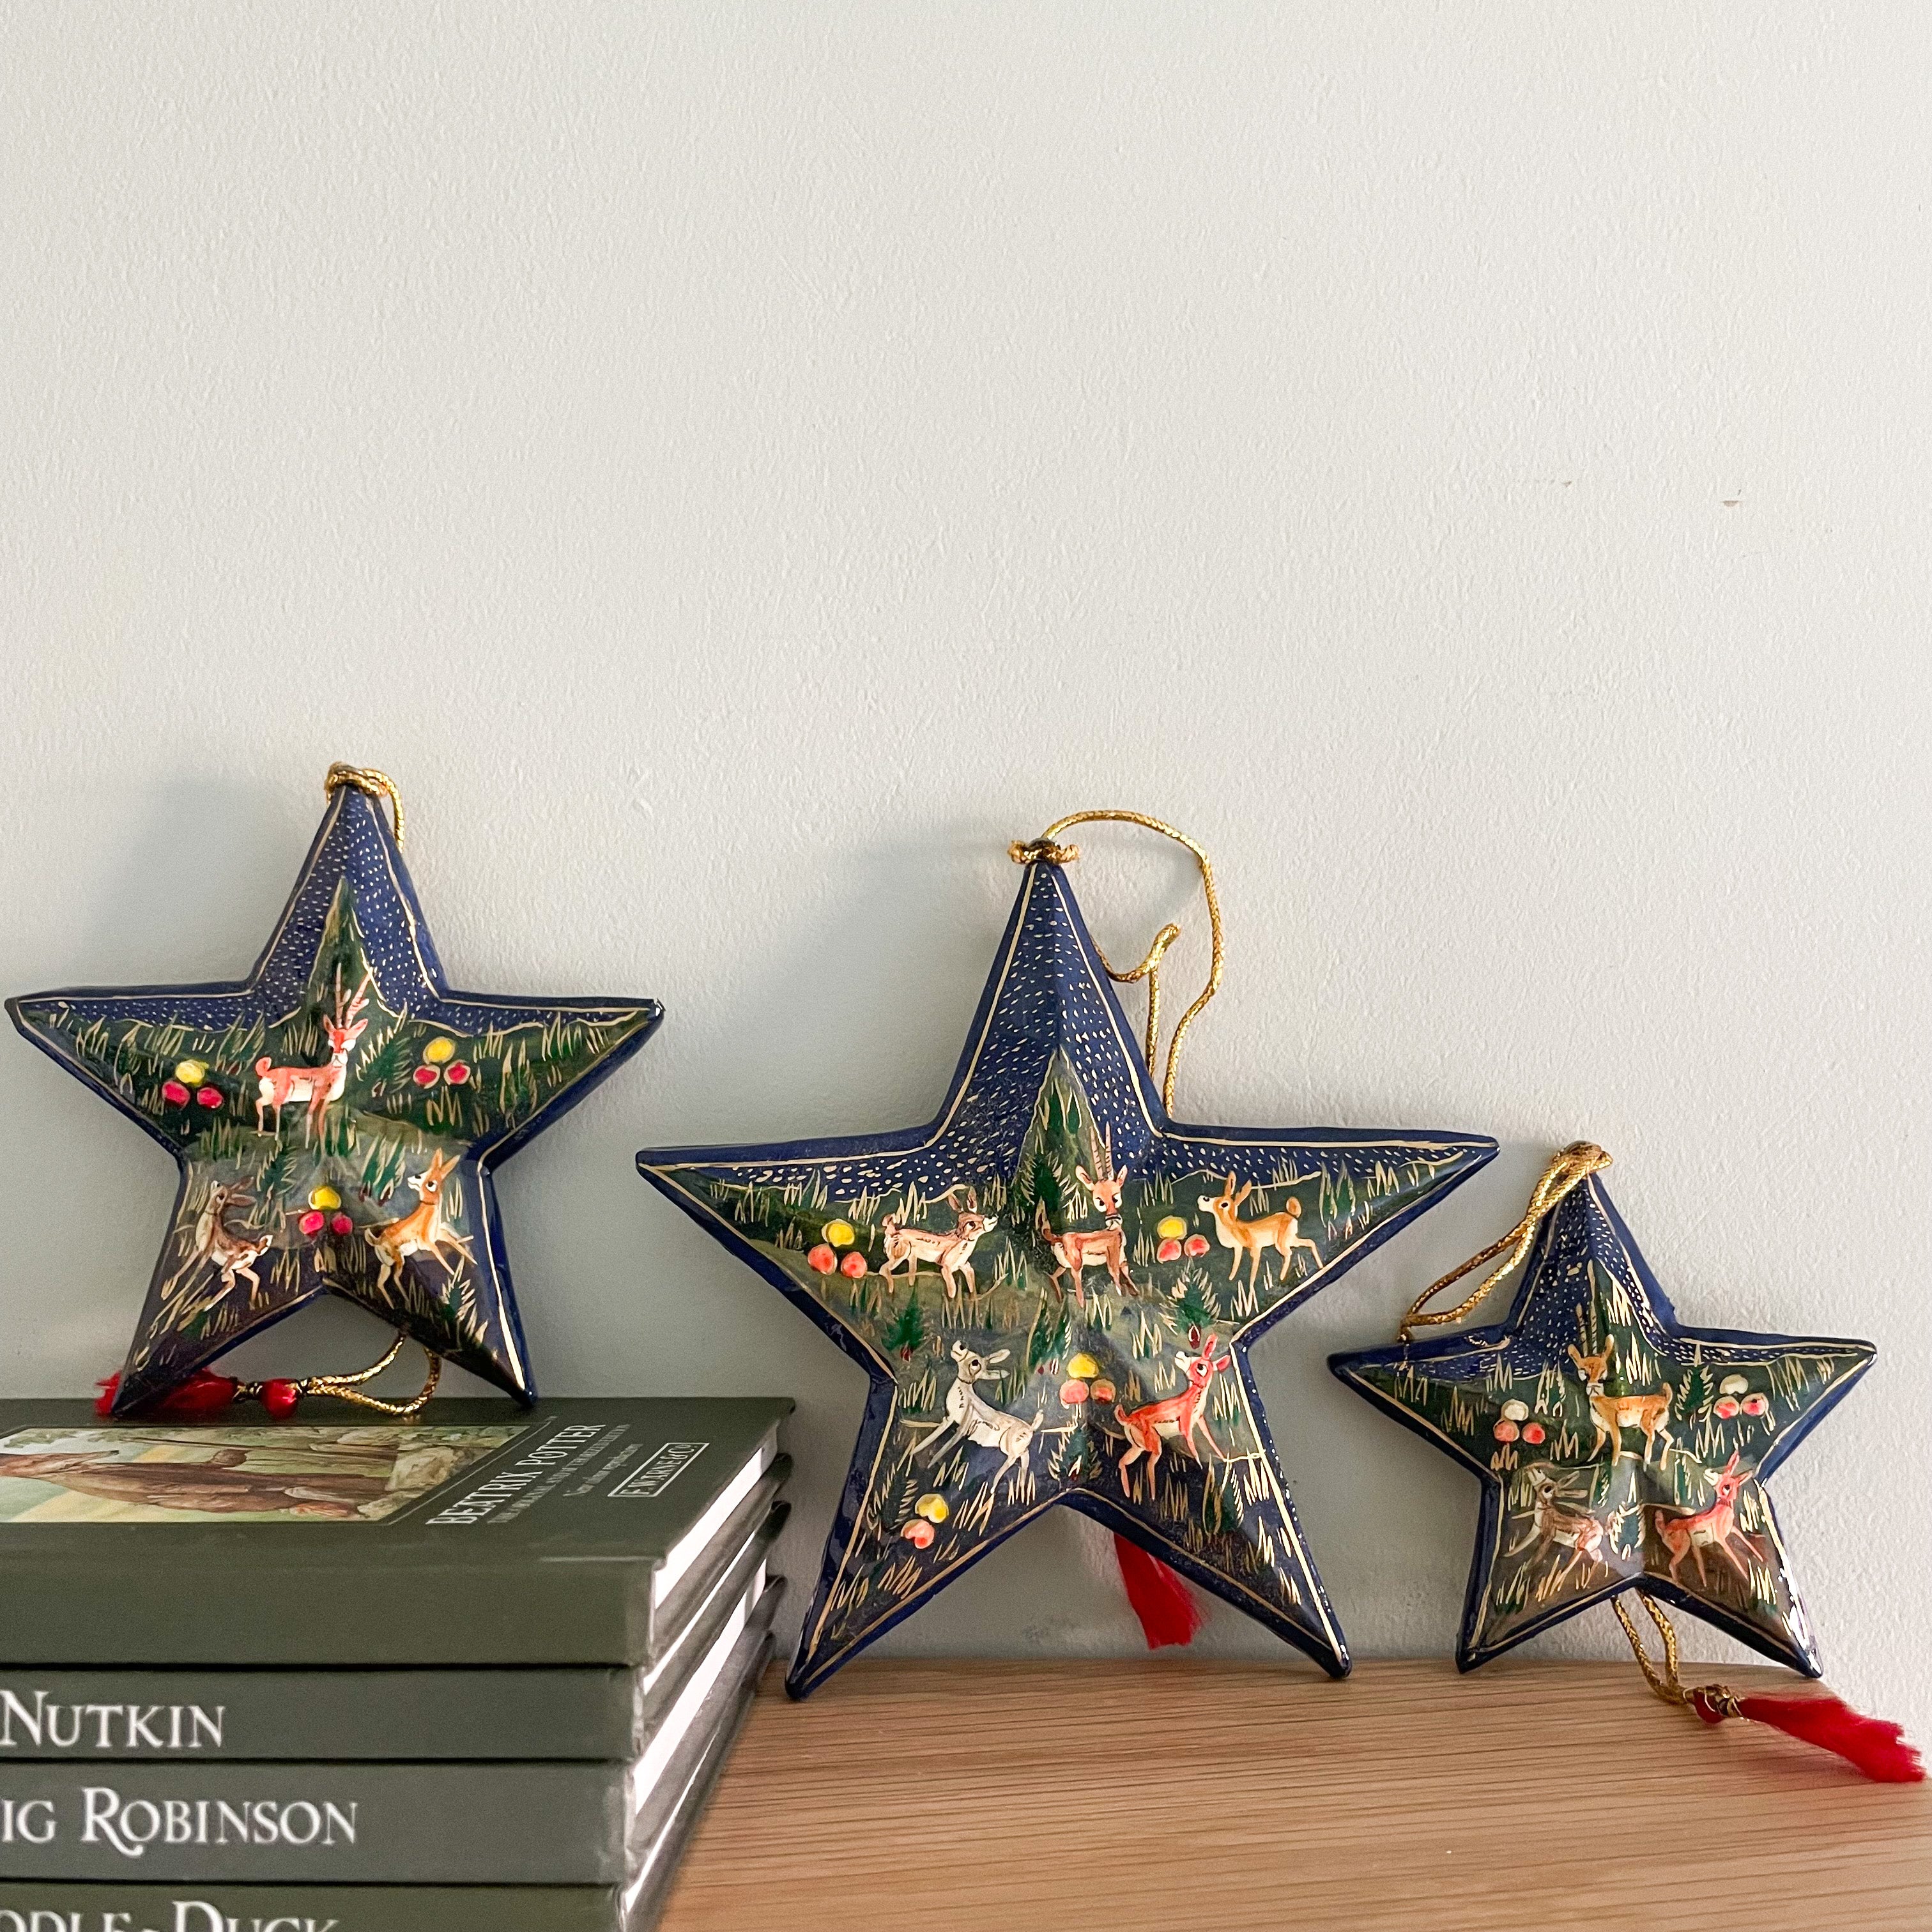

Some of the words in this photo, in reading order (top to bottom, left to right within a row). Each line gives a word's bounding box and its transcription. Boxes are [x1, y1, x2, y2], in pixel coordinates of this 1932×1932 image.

[425, 1471, 542, 1524] BEATRIX
[514, 1424, 606, 1466] POTTER
[0, 1690, 226, 1748] NUTKIN
[80, 1788, 358, 1858] ROBINSON
